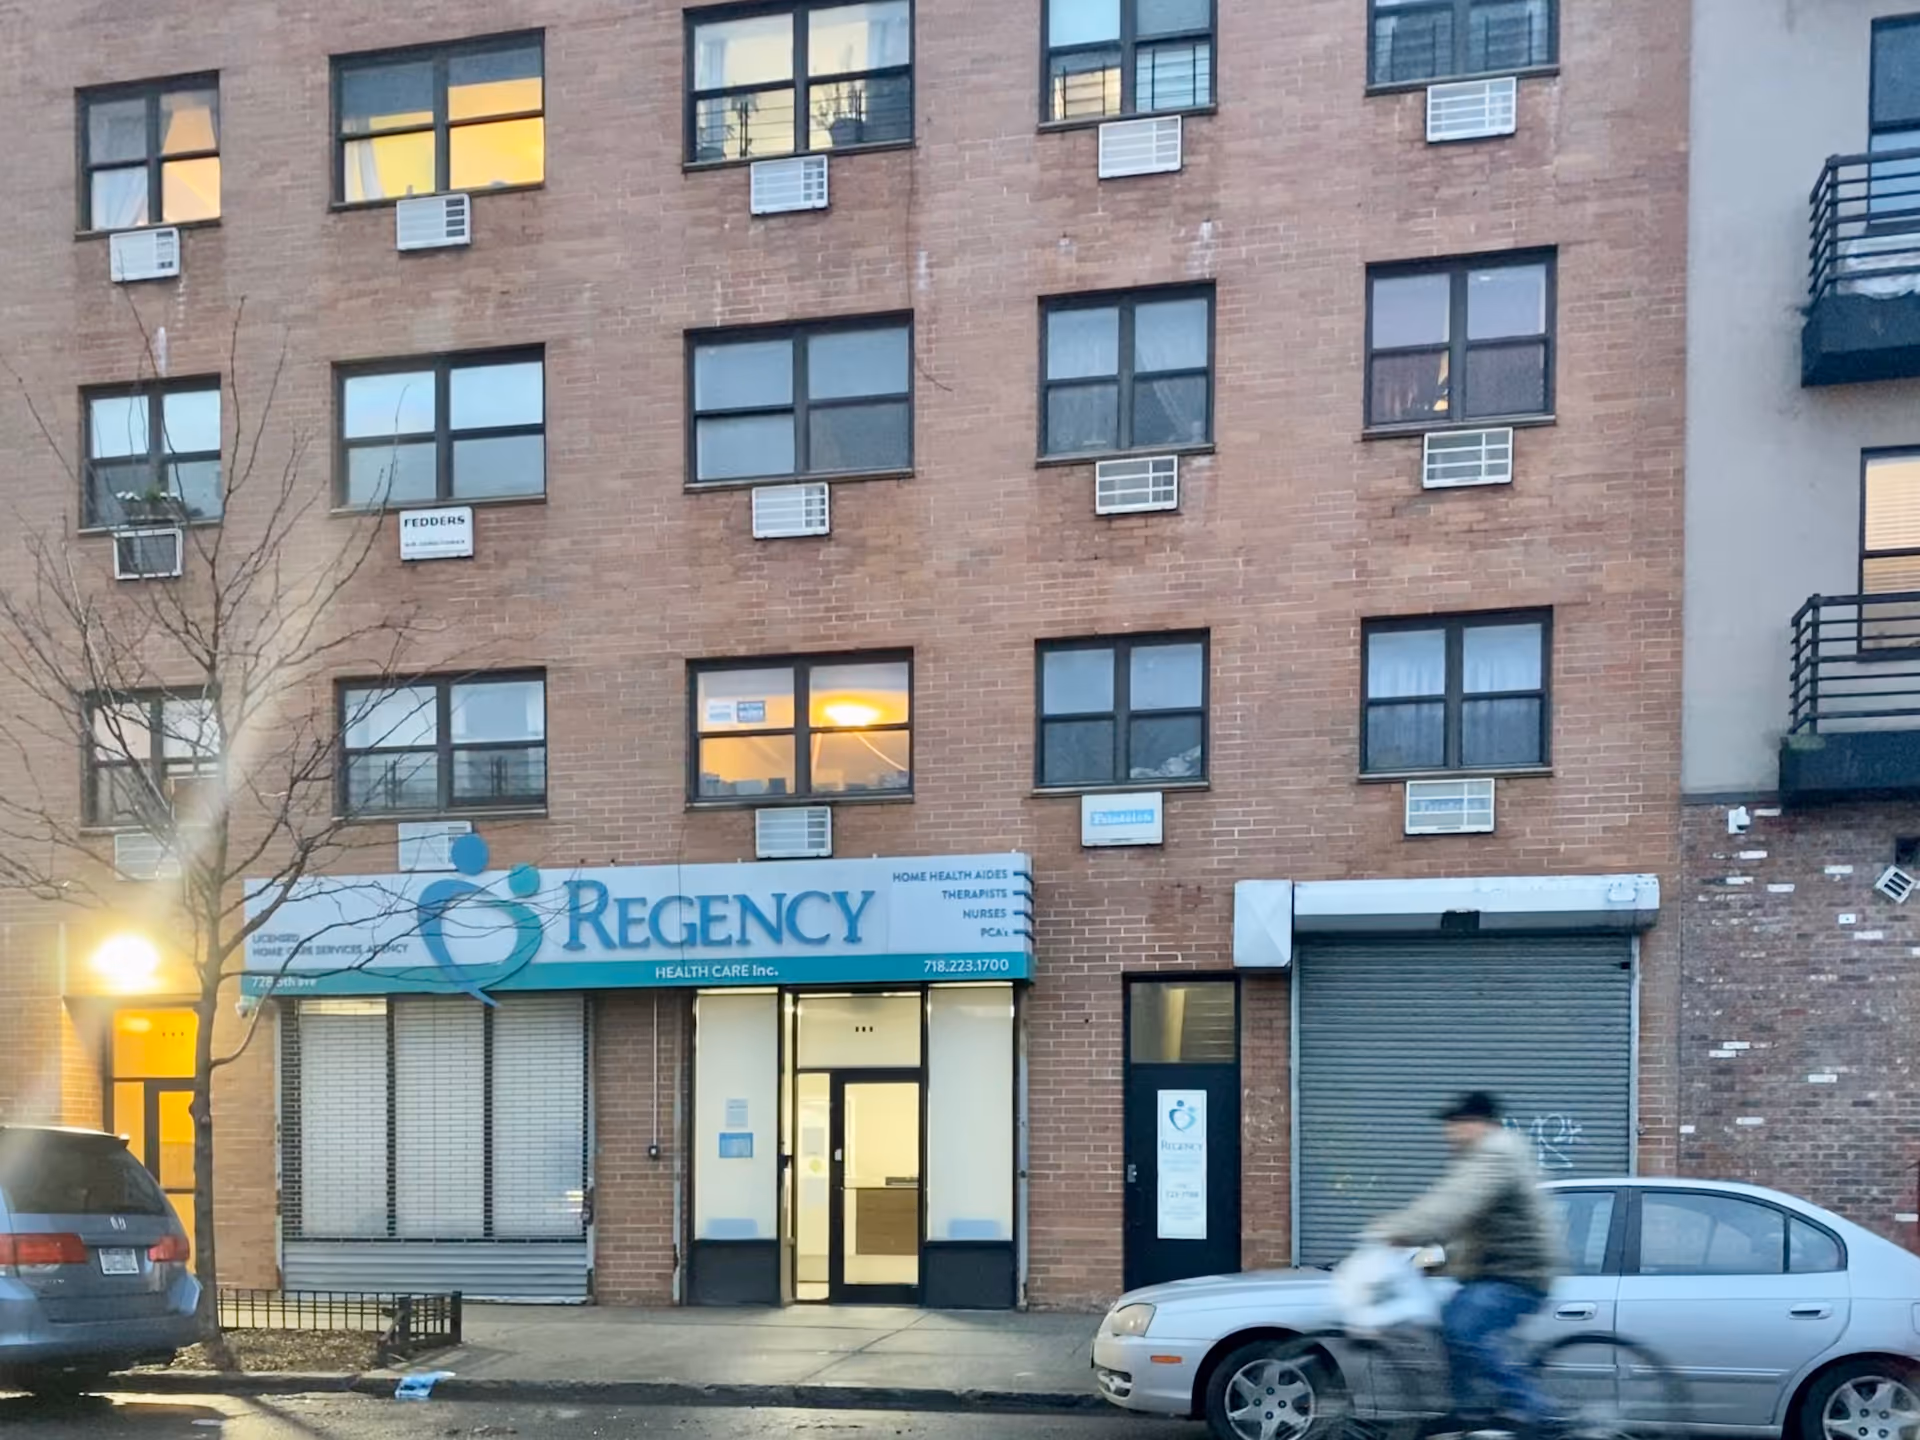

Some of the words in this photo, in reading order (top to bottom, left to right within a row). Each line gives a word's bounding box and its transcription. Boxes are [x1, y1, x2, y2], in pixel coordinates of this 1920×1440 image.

[404, 515, 465, 528] FEDDERS
[892, 871, 927, 882] HOME
[929, 869, 972, 881] HEALTH
[975, 869, 1008, 880] AIDES
[941, 888, 1008, 900] THERAPISTS
[562, 879, 876, 951] REGENCY
[962, 908, 1007, 919] NURSES
[252, 947, 283, 957] HOME
[315, 944, 362, 955] SERVICES
[655, 965, 709, 979] HEALTH
[711, 964, 749, 978] CARE
[752, 964, 779, 977] Inc.
[923, 958, 1010, 973] 718.223.1700
